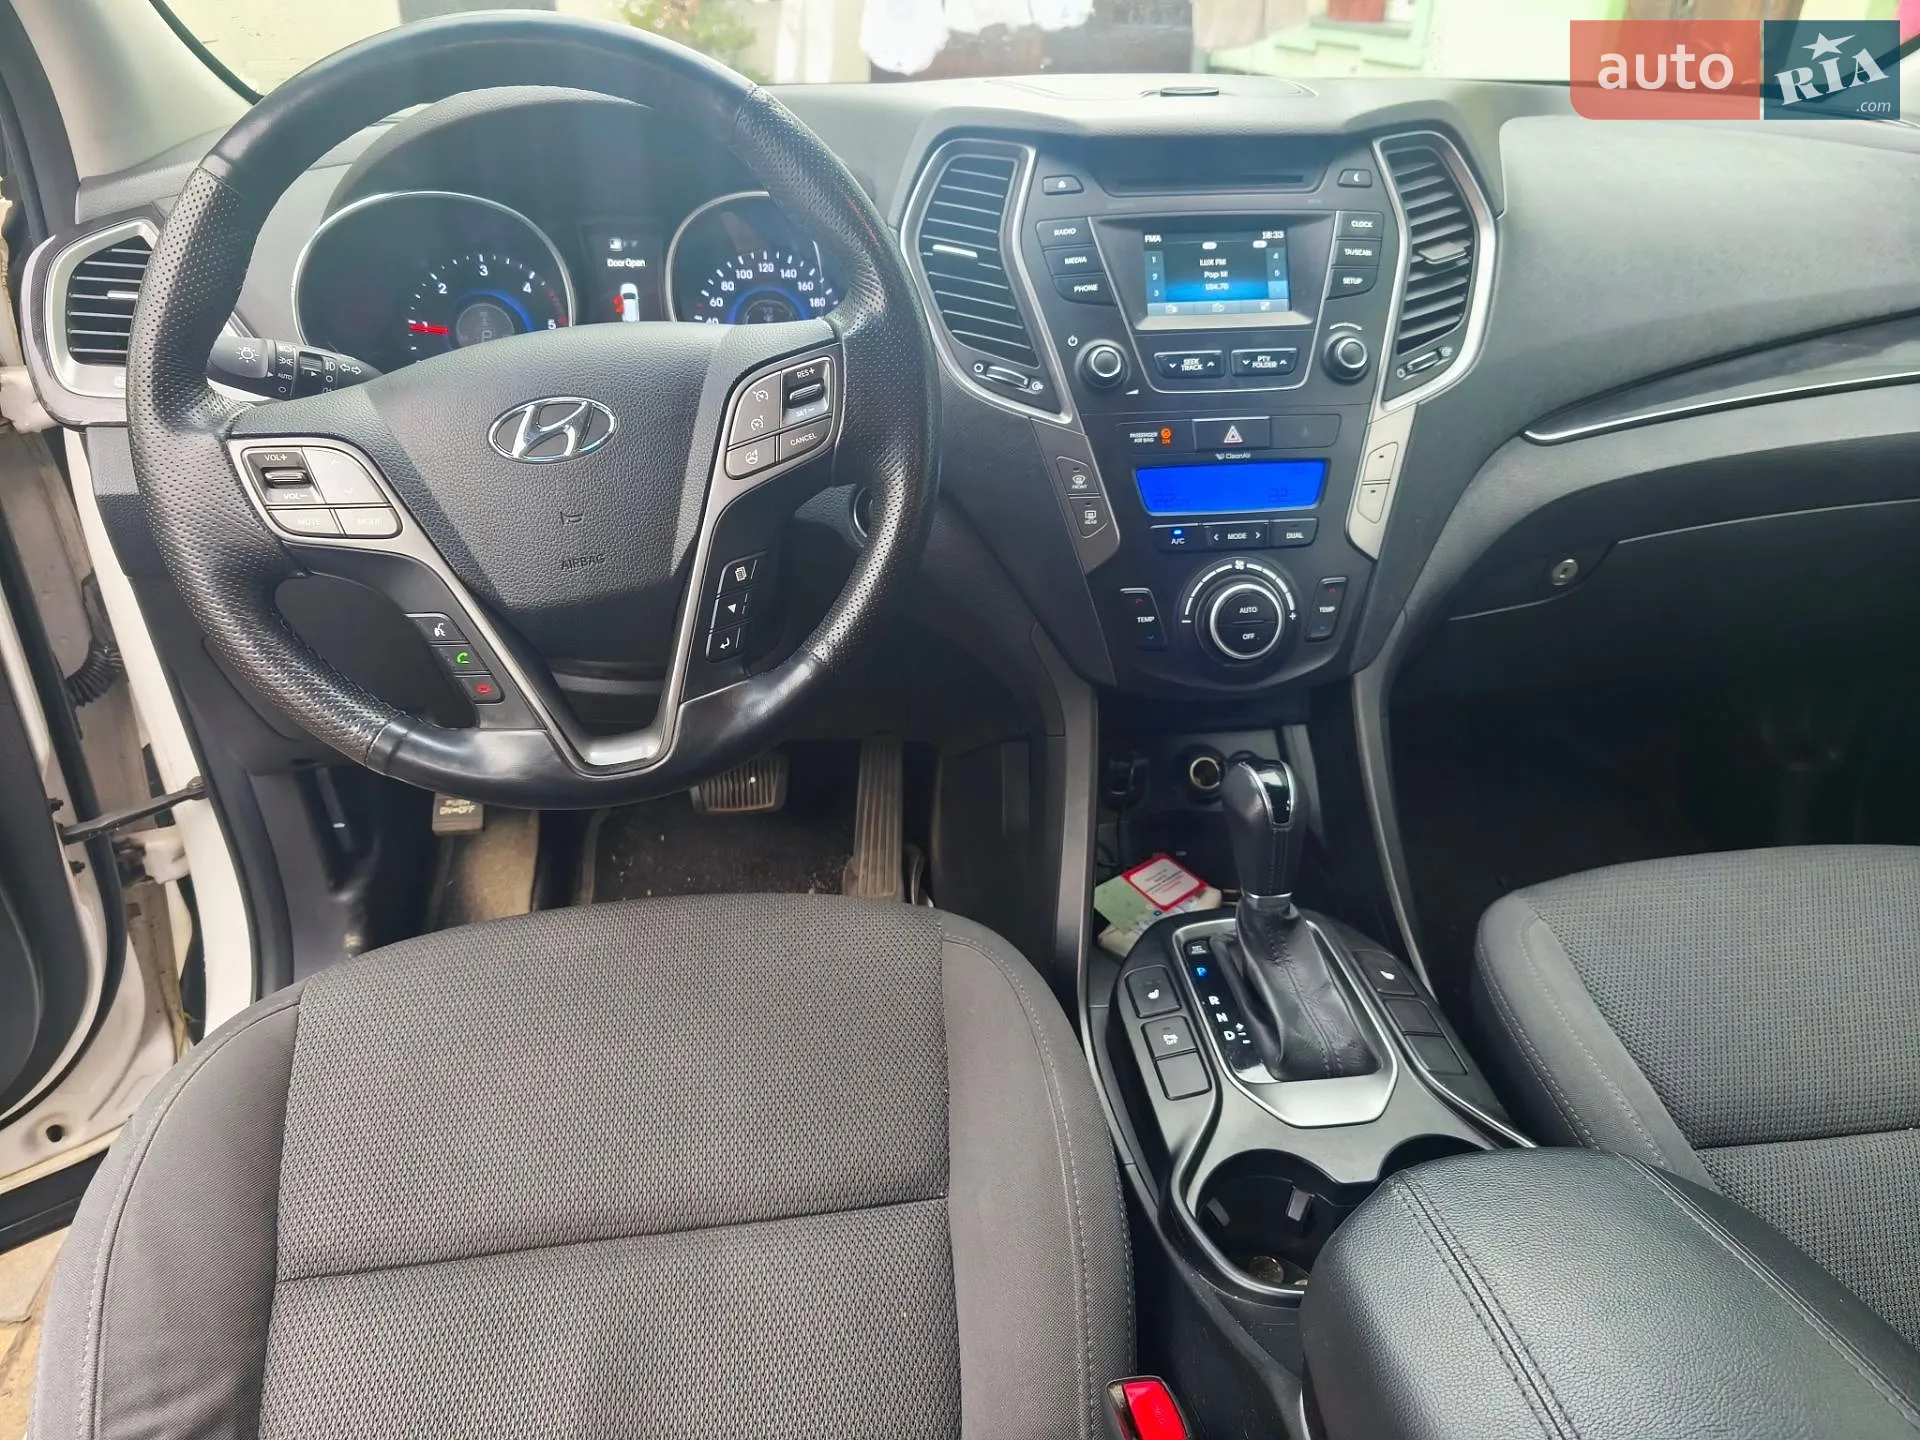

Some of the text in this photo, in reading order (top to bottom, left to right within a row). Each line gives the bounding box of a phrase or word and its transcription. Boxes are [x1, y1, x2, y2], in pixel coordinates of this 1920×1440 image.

[1351, 220, 1373, 228] CLOCK
[1053, 227, 1077, 236] RADIO
[1145, 235, 1161, 243] FMA
[607, 258, 646, 268] Door Open
[1064, 256, 1087, 265] MEDIA
[479, 264, 488, 276] 3
[758, 262, 774, 272] 120
[736, 269, 753, 279] 100
[780, 268, 797, 279] 140
[1204, 271, 1219, 279] Pop
[721, 281, 734, 291] 80
[798, 281, 814, 291] 160
[1342, 277, 1363, 285] SETUP
[438, 283, 447, 294] 2
[523, 281, 532, 293] 4
[1073, 283, 1098, 293] PHONE
[709, 298, 723, 307] 60
[809, 297, 826, 307] 180
[547, 318, 556, 330] 5
[1181, 364, 1203, 372] TRACK
[278, 372, 293, 381] AUTO
[790, 432, 817, 446] CANCEL
[357, 517, 382, 525] MODE
[1171, 537, 1185, 545] A/C
[1227, 532, 1247, 540] MODE
[561, 555, 606, 570] AIRBAG
[1239, 606, 1258, 614] AUTO
[1196, 966, 1207, 976] P
[1208, 996, 1220, 1005] R
[1216, 1012, 1228, 1022] N
[1223, 1030, 1235, 1040] D
